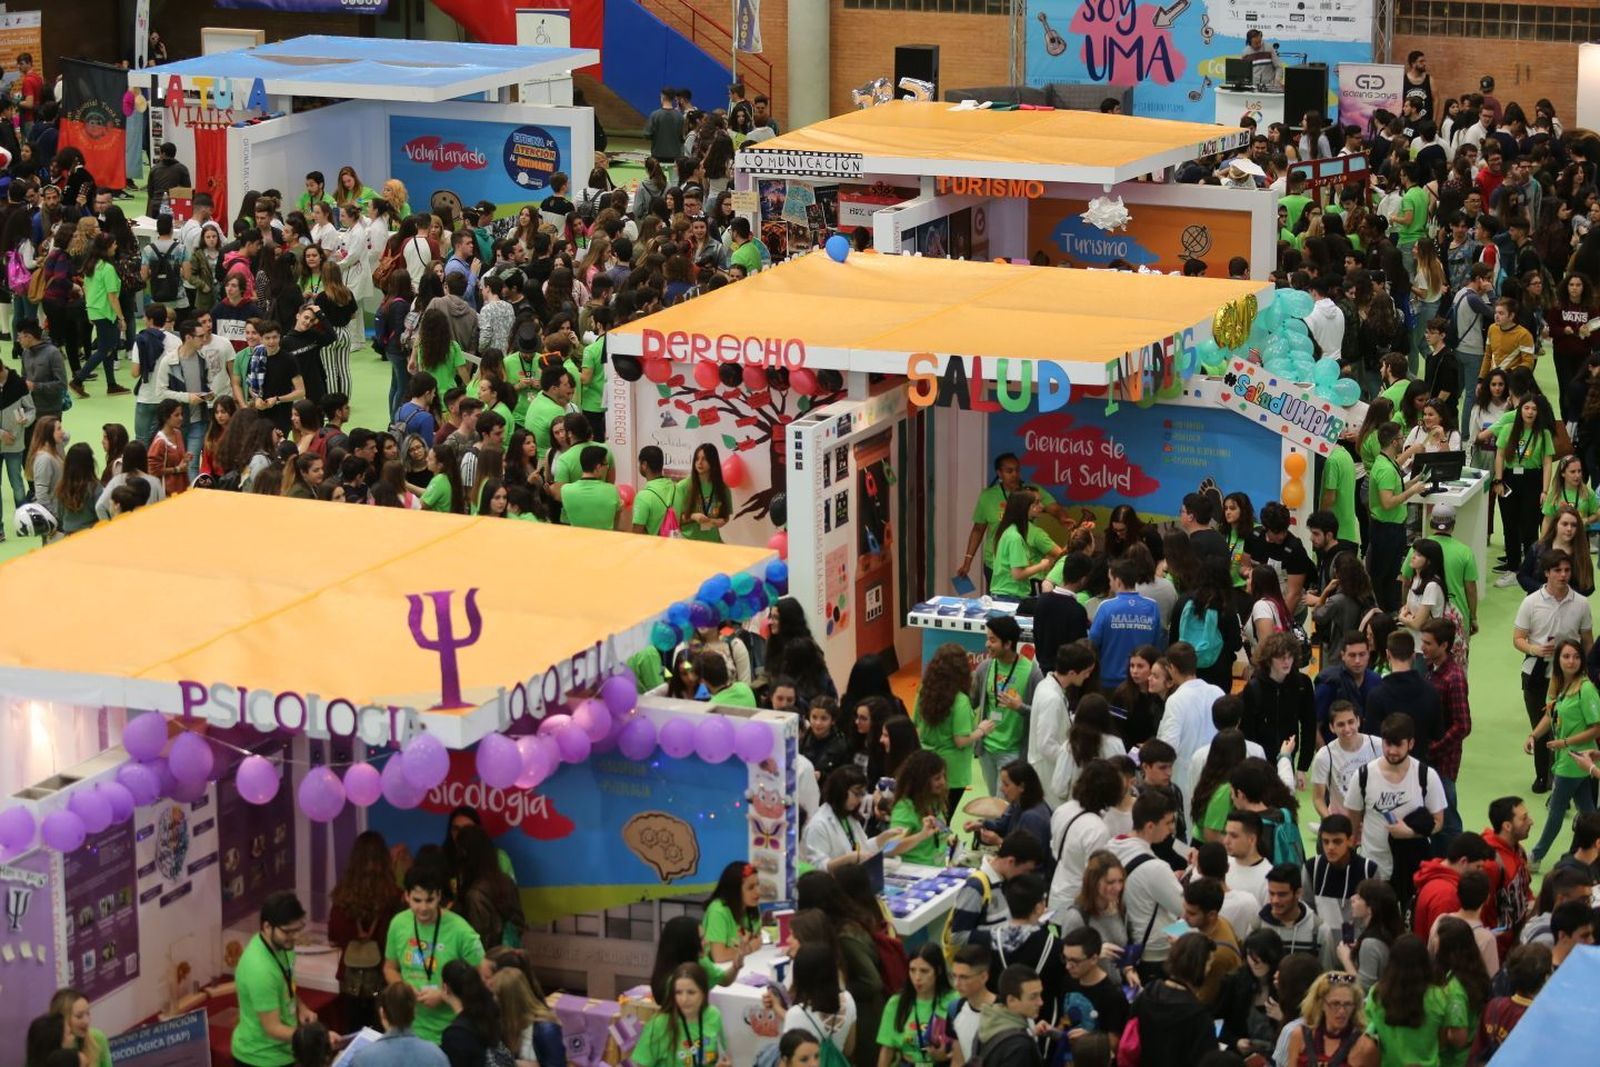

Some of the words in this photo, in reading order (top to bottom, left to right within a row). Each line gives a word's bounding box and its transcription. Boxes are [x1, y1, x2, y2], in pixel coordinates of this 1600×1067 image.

[1085, 34, 1175, 82] UMA
[744, 155, 861, 172] COMUNICACIÓN
[937, 175, 1044, 199] TURISMO
[1061, 232, 1128, 258] Turismo
[1561, 310, 1588, 323] VANS
[907, 352, 1071, 413] SALUD
[614, 400, 627, 446] DERECHO
[1024, 430, 1095, 460] Ciencias
[1100, 440, 1126, 459] de
[1054, 465, 1073, 485] la
[1078, 465, 1132, 491] Salud
[429, 780, 549, 827] sicología
[1377, 790, 1406, 806] NIKE
[111, 1038, 166, 1061] SICOLÓGICA
